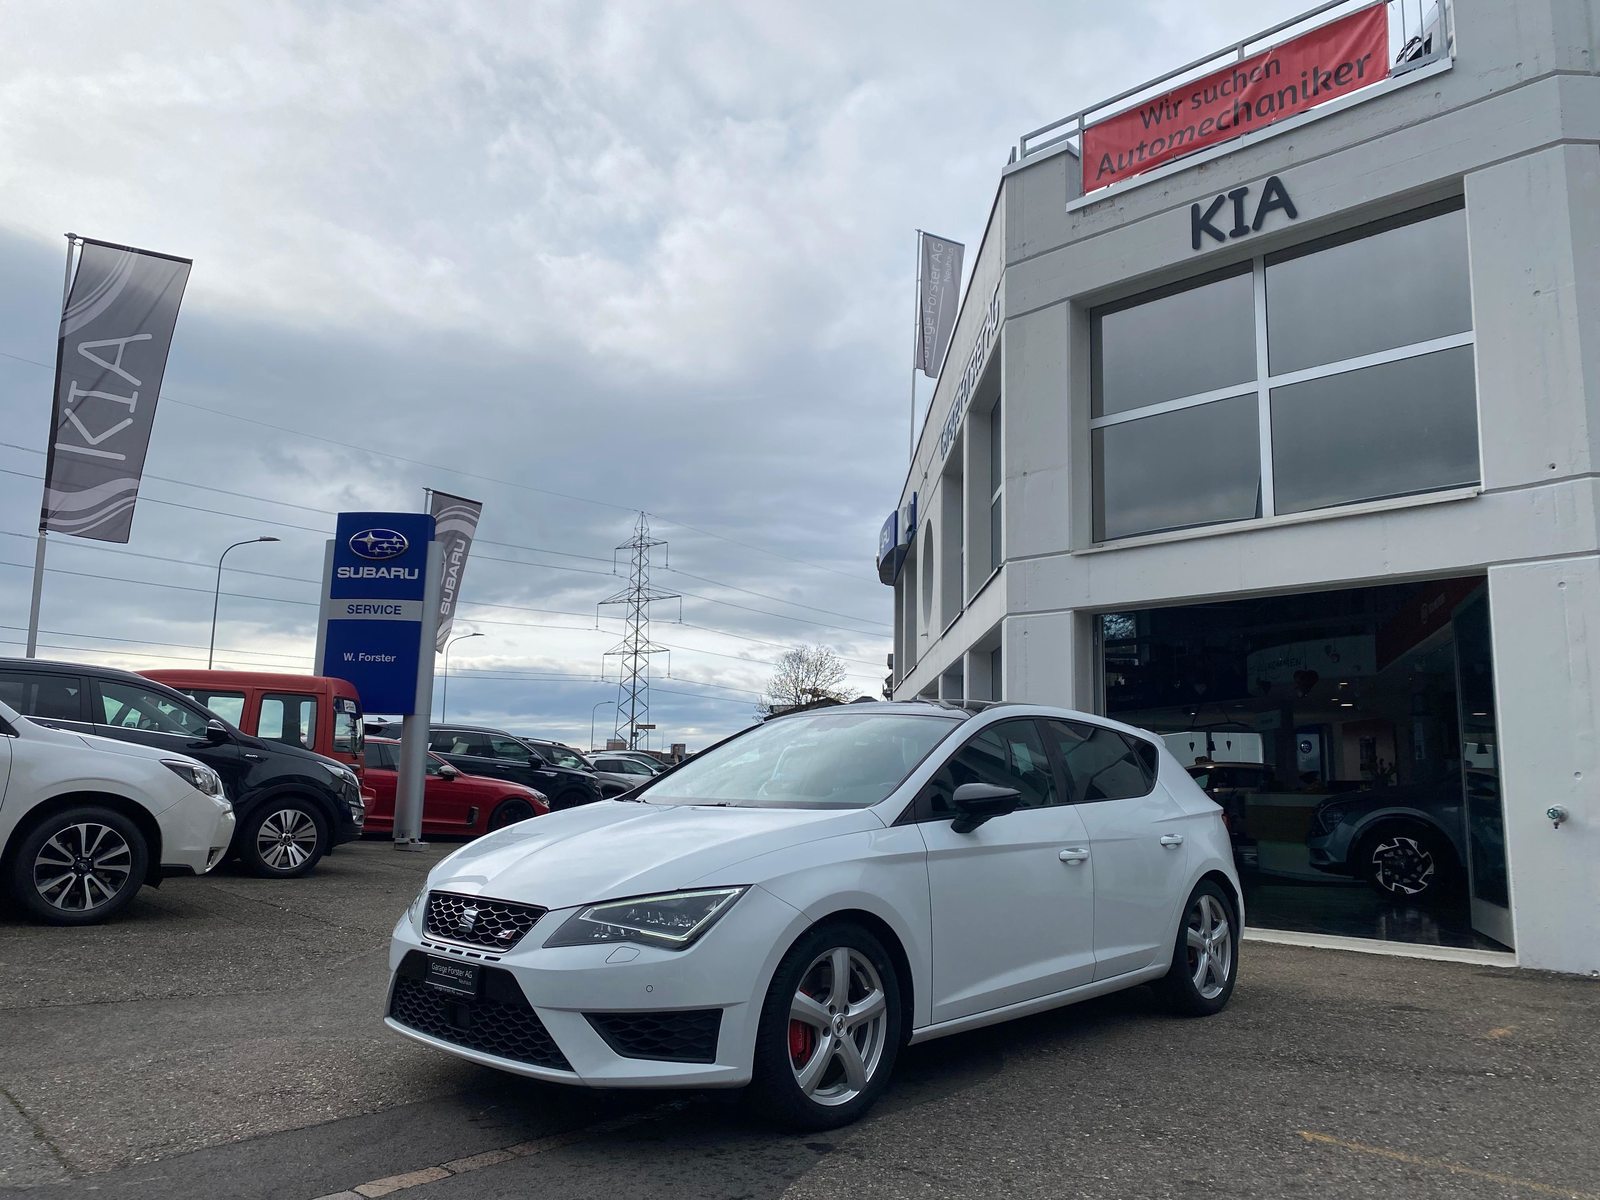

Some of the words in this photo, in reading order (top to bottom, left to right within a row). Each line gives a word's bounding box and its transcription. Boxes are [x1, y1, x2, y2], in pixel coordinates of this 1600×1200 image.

[1139, 97, 1183, 129] Wir
[1191, 56, 1281, 111] suchen
[1096, 52, 1372, 181] Automechaniker
[1191, 175, 1298, 250] KIA
[931, 243, 944, 263] AG
[925, 267, 941, 314] Forster
[54, 333, 153, 461] KIA
[337, 566, 419, 580] SUBARU
[441, 539, 466, 615] SUBARU
[346, 604, 402, 615] SERVICE
[343, 652, 355, 662] W.
[358, 652, 397, 662] Forster
[432, 962, 448, 974] Garage
[448, 966, 464, 976] Forster
[465, 970, 473, 979] AG
